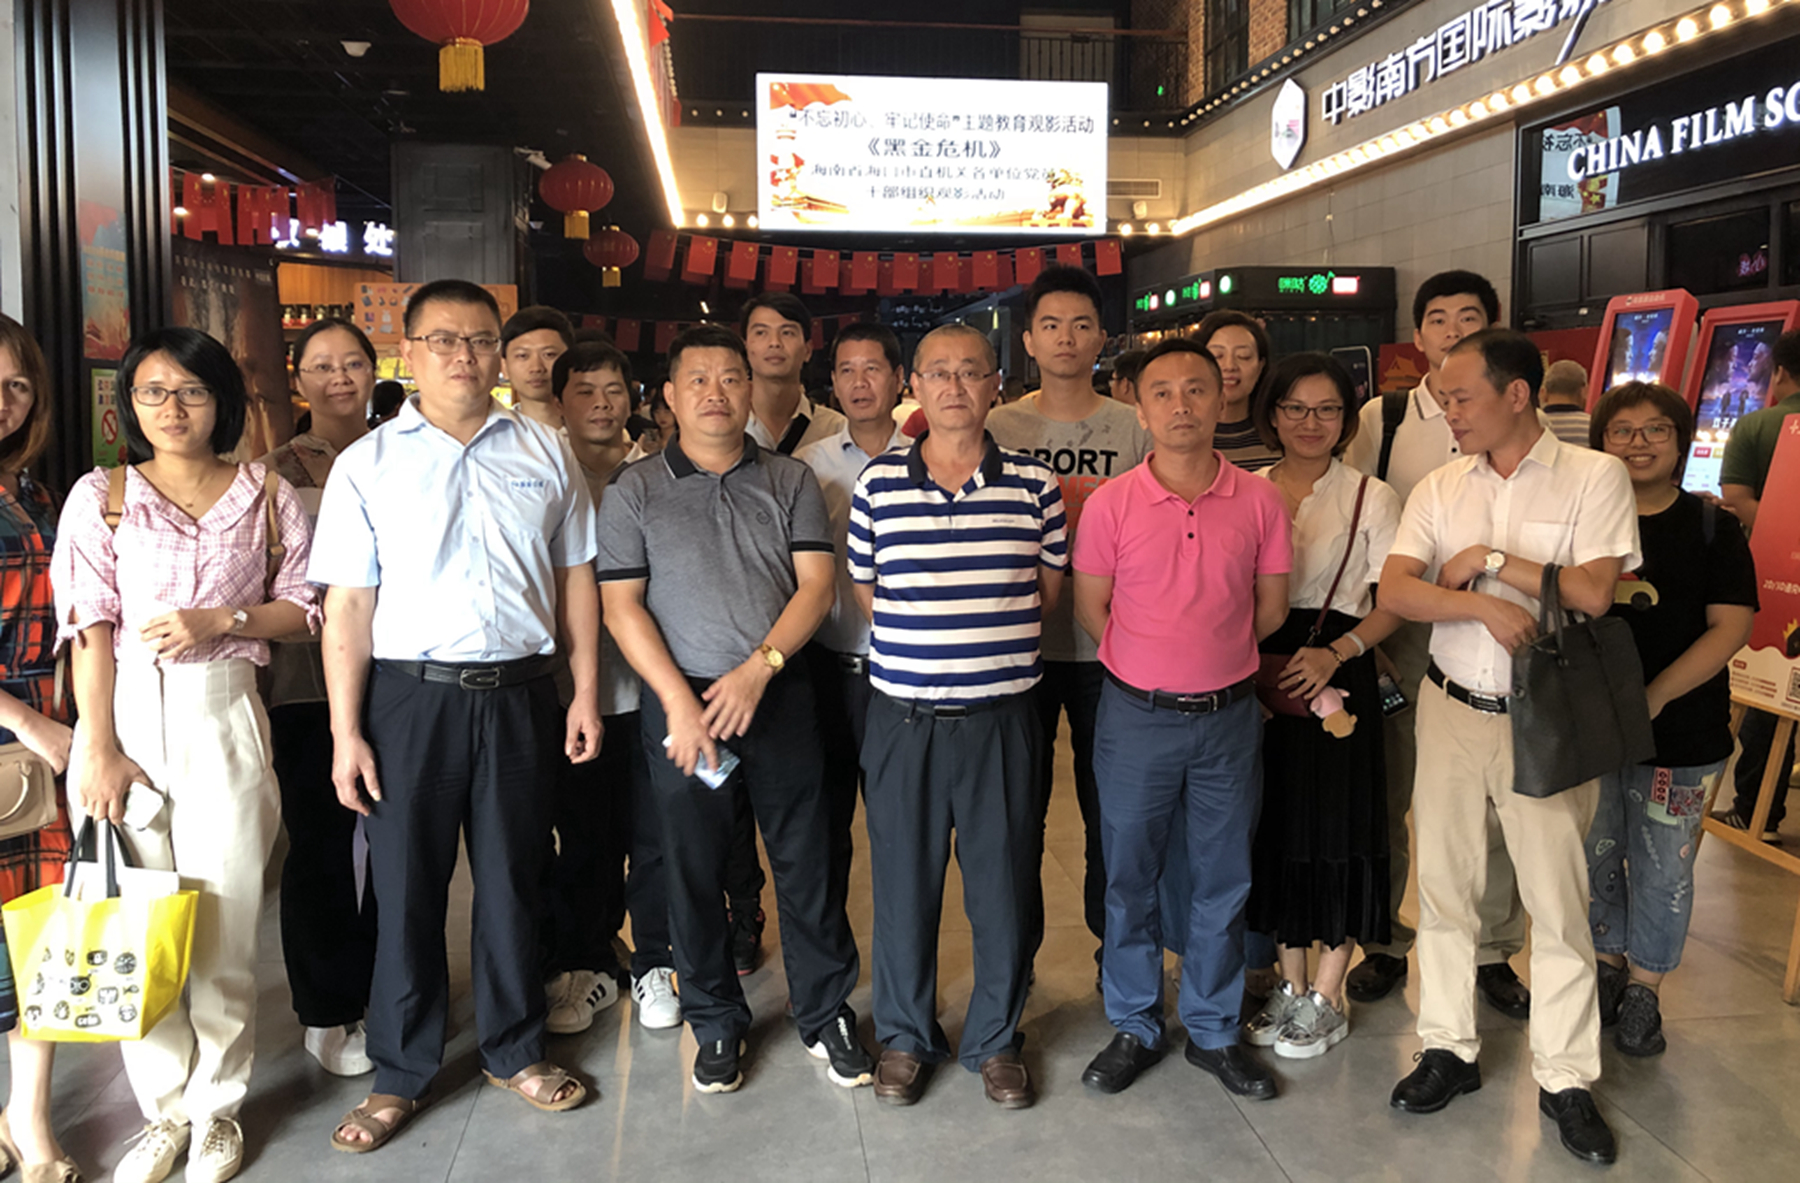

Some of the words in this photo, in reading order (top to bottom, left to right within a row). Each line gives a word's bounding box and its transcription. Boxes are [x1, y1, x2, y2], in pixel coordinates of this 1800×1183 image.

[868, 137, 1001, 158] 《黑金危机》
[1566, 125, 1664, 181] CHINA
[1671, 95, 1757, 155] FILM
